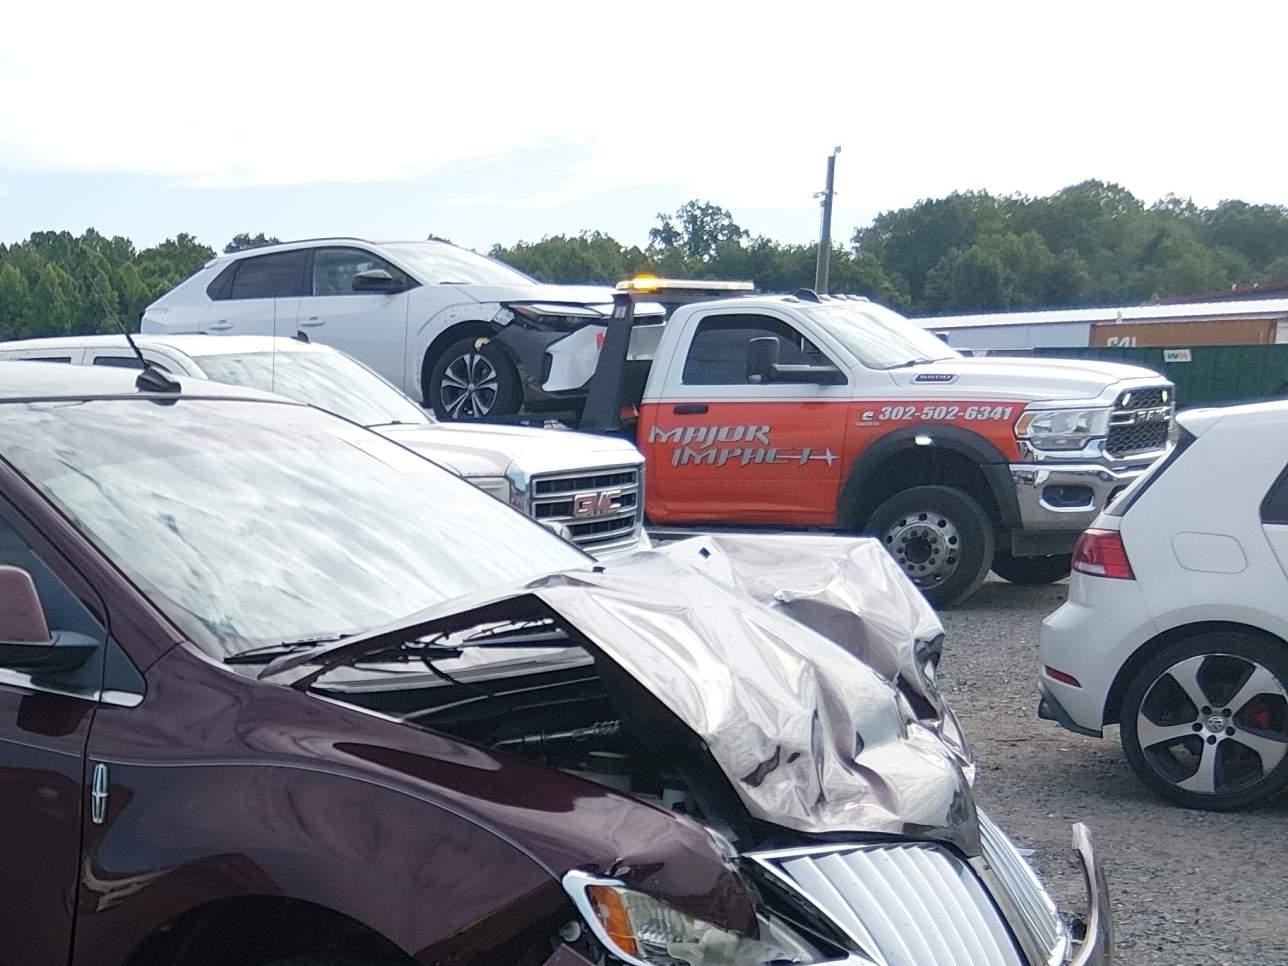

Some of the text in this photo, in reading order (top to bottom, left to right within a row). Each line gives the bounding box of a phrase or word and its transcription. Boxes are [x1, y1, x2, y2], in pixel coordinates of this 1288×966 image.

[878, 406, 1014, 421] 302-502-6341
[647, 425, 772, 449] MAJOR
[671, 447, 824, 468] IMPACT
[574, 489, 622, 518] GMC
